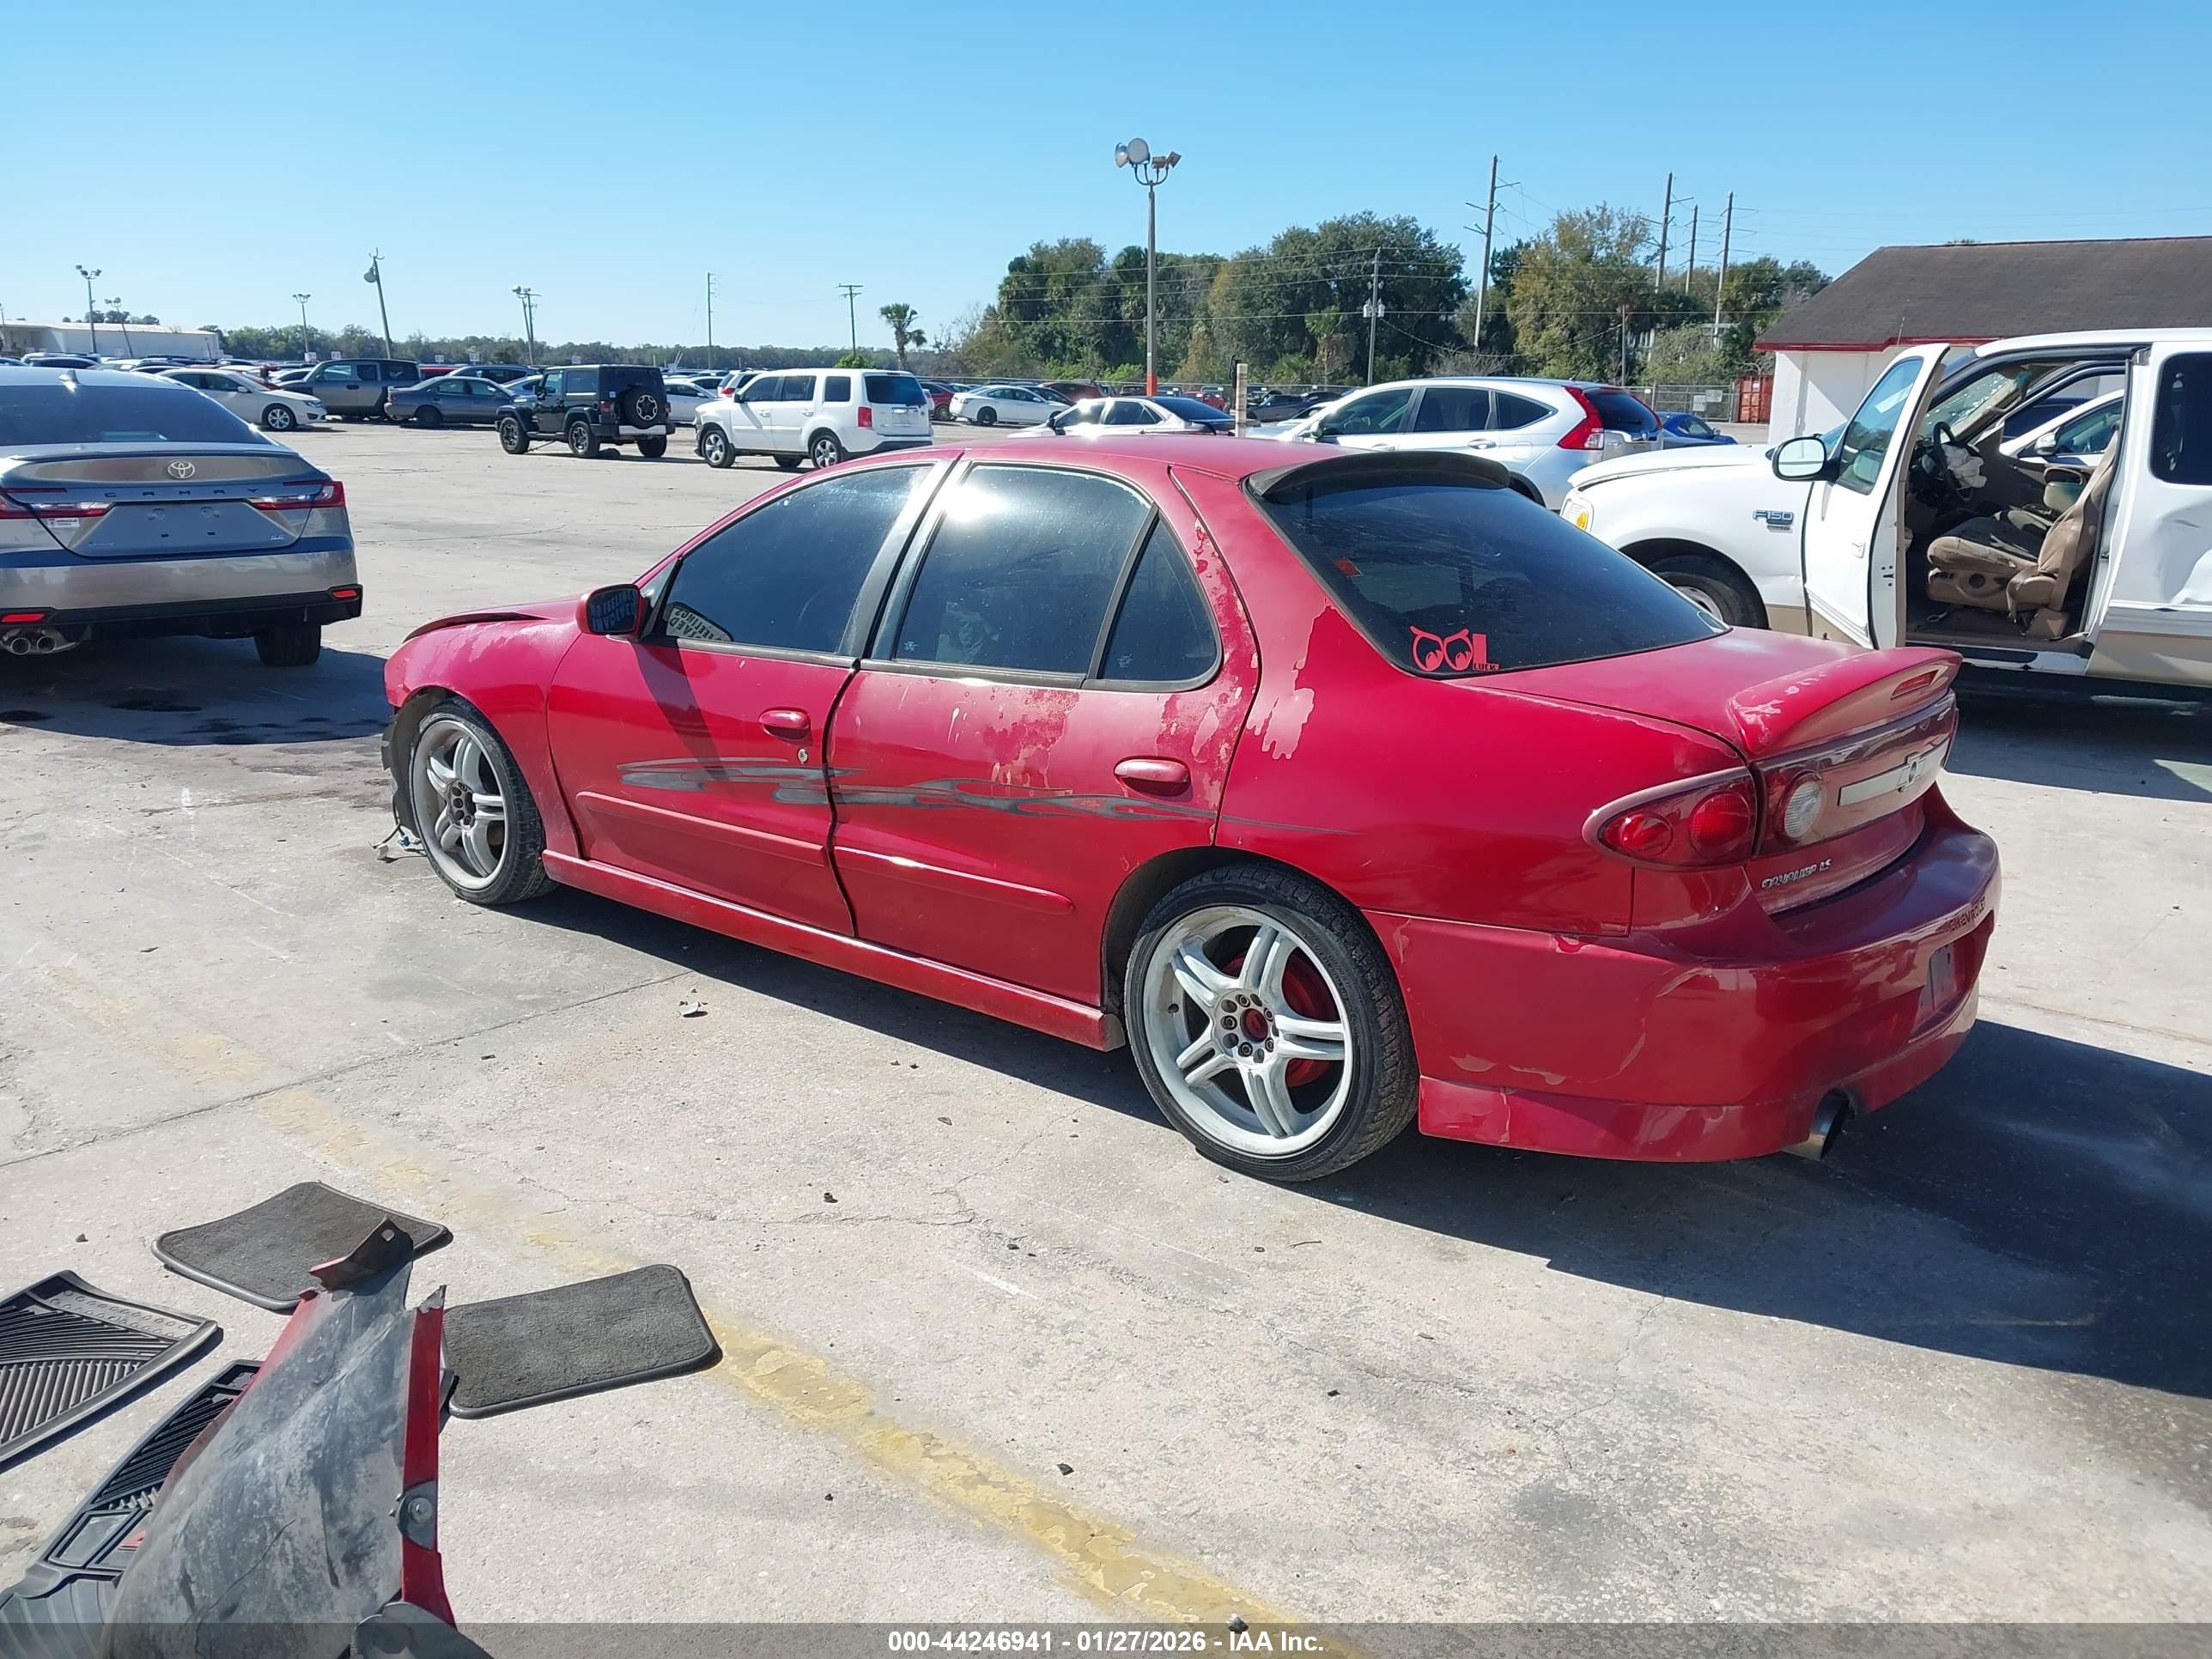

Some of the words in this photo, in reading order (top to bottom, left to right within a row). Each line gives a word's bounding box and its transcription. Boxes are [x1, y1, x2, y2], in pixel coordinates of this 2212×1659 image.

[104, 488, 258, 497] CAMRY
[1820, 859, 1832, 872] LS
[1949, 893, 1986, 932] CHEVROLET
